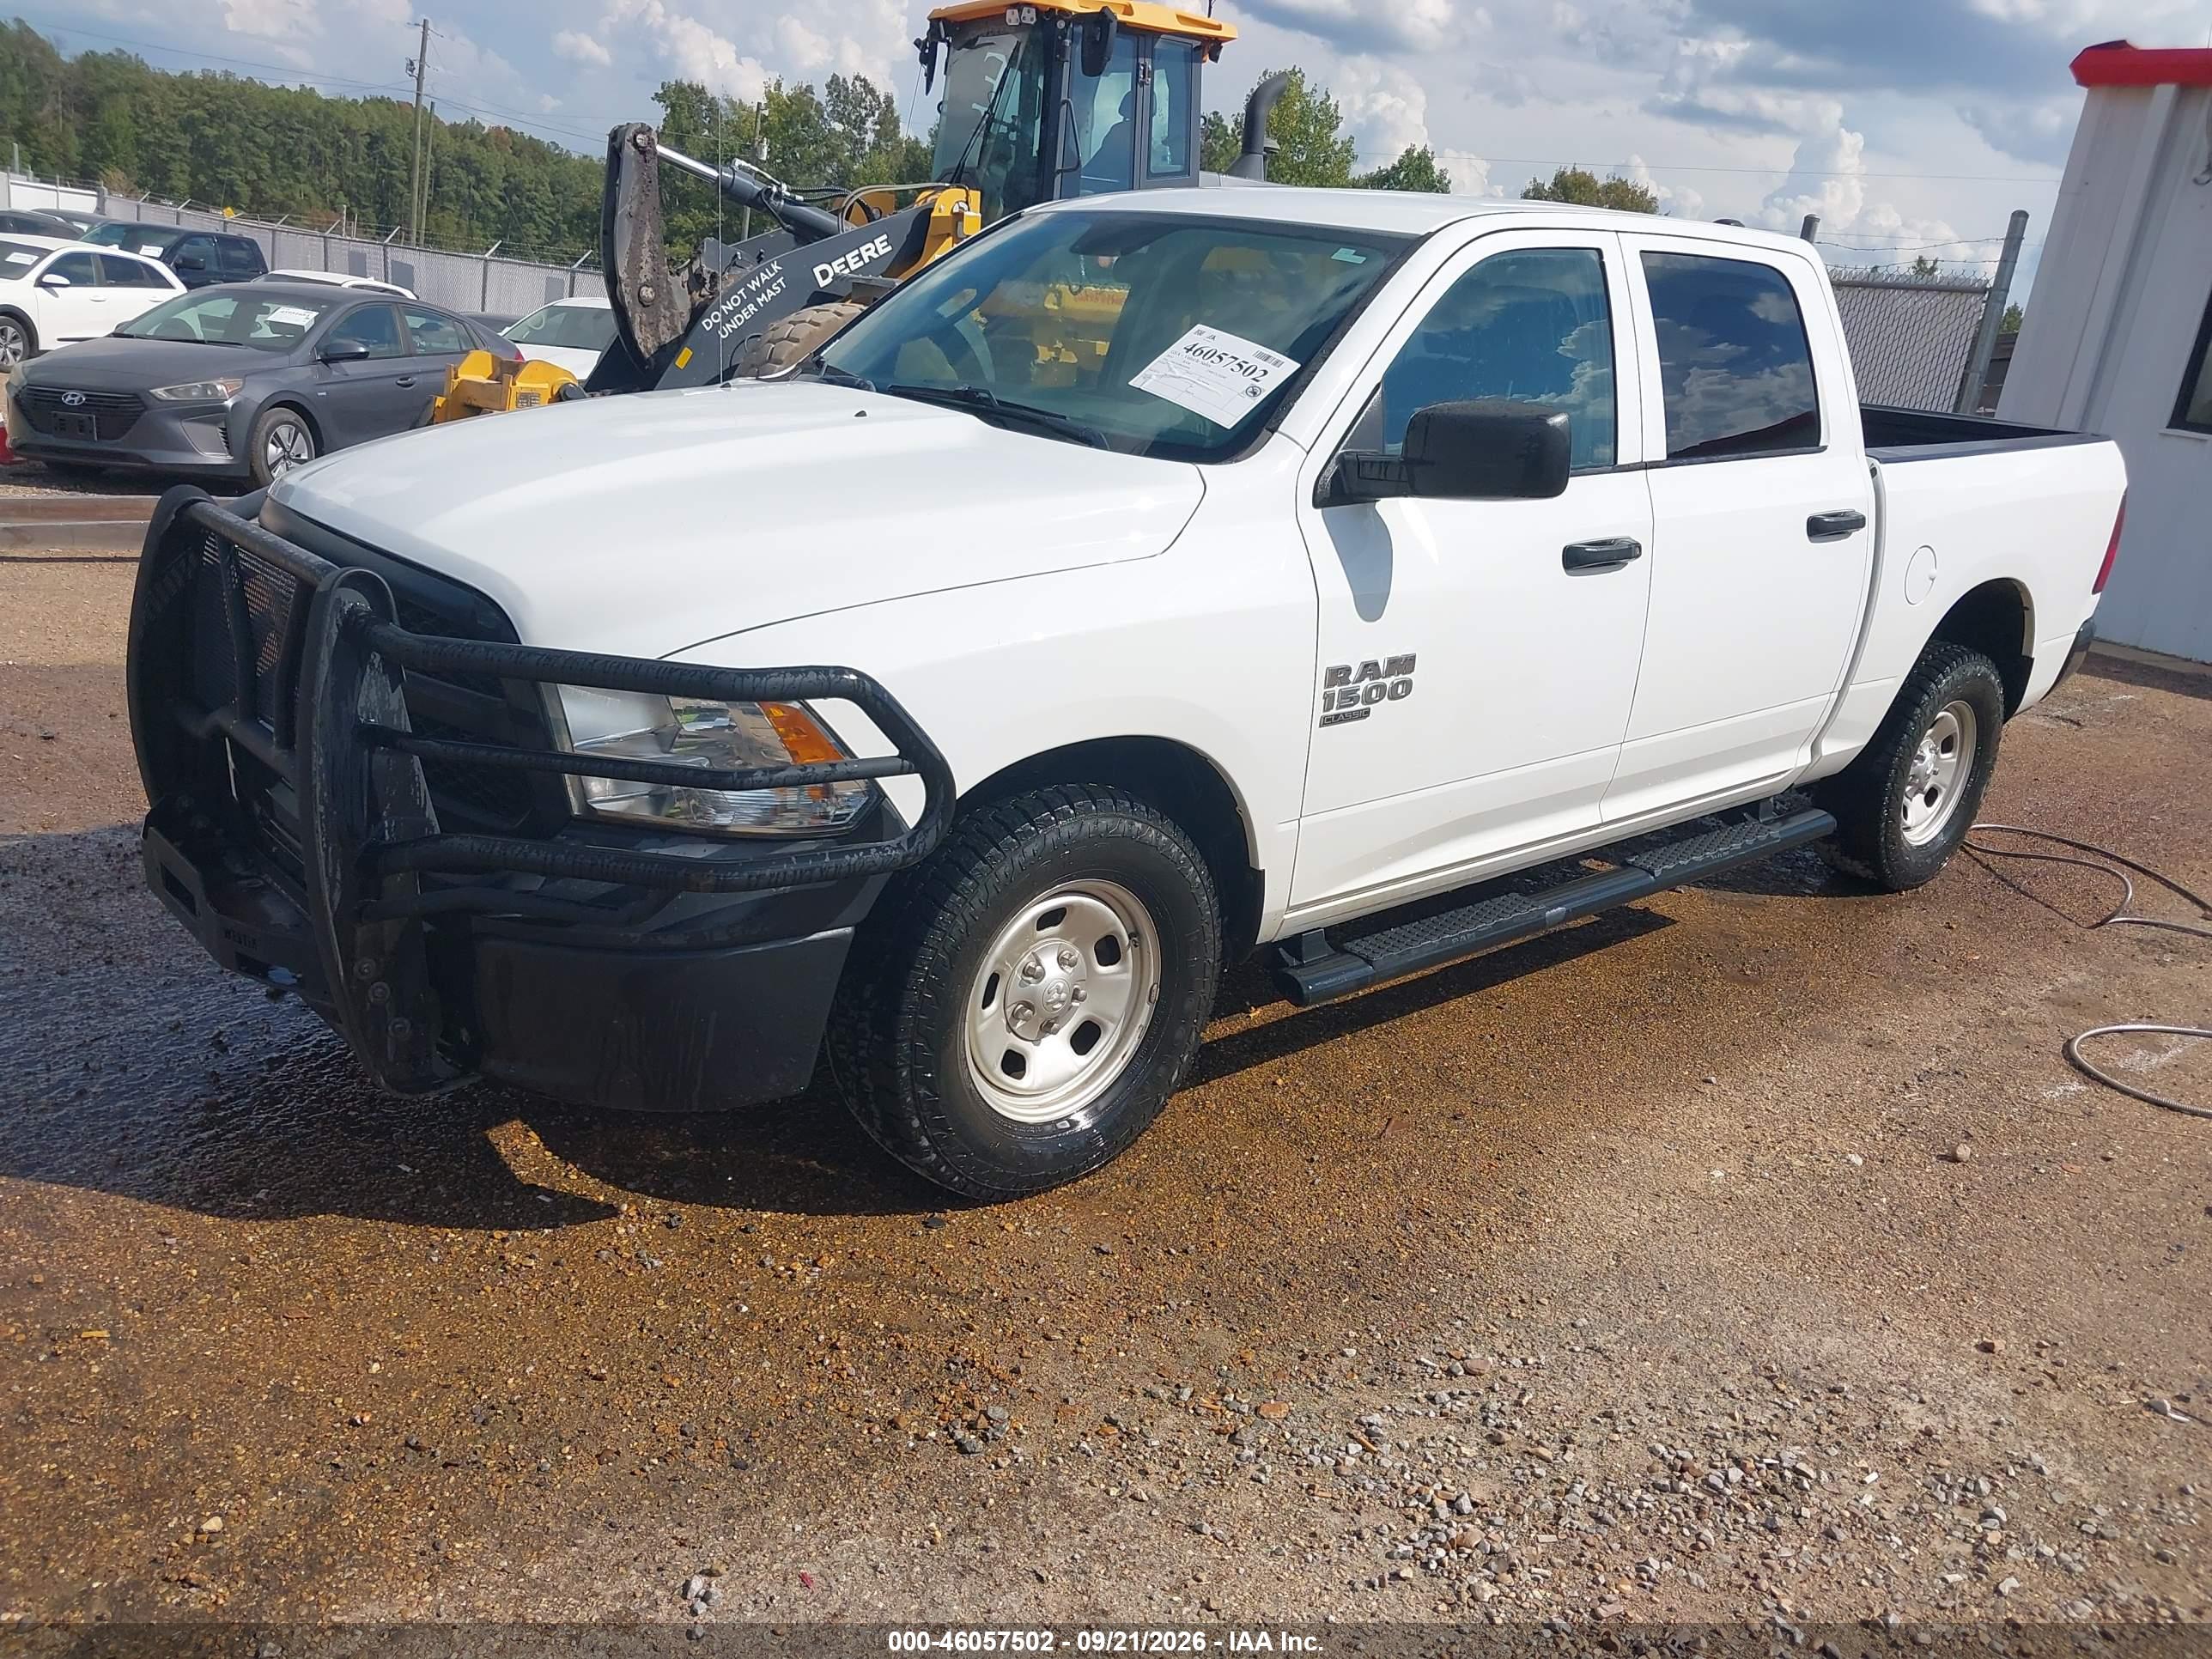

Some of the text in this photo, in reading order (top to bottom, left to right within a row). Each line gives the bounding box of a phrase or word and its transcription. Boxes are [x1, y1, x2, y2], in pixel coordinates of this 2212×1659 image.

[812, 233, 893, 289] DEERE
[702, 260, 783, 331] DO NOT WALK
[718, 276, 787, 338] UNDER MAST
[1182, 342, 1269, 383] 46057502
[1324, 653, 1416, 690] RAM
[1322, 678, 1413, 714] 1500
[1322, 708, 1370, 724] CLASSIC
